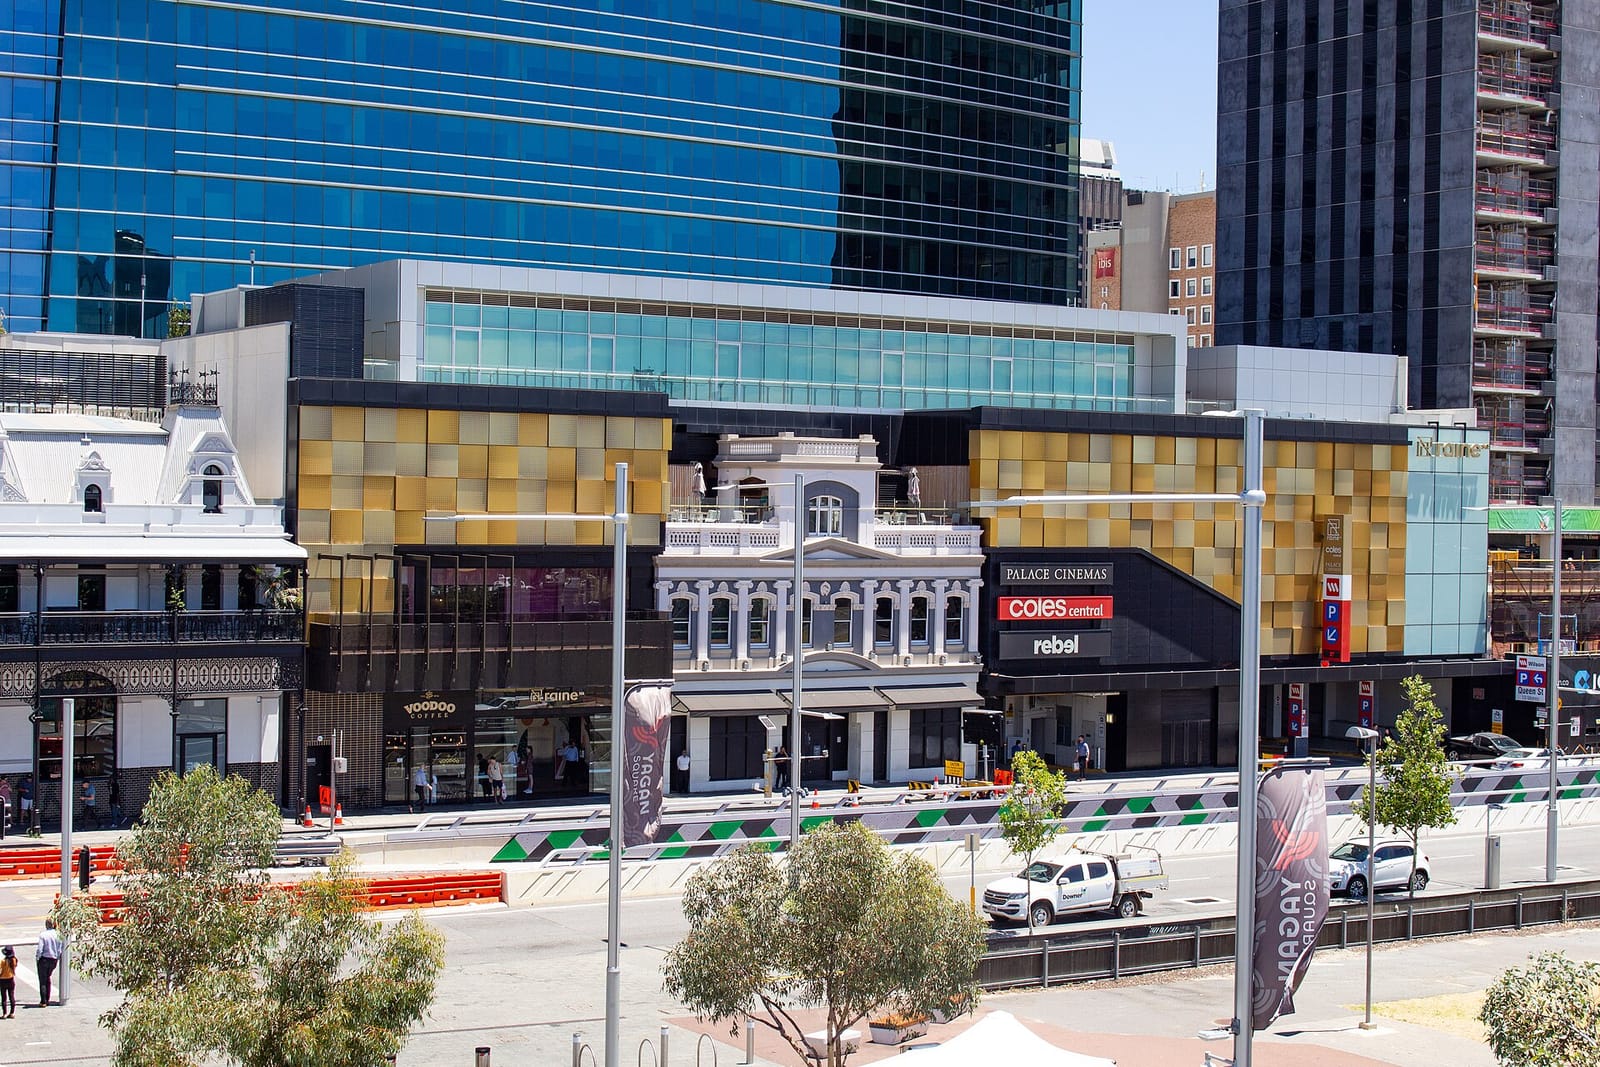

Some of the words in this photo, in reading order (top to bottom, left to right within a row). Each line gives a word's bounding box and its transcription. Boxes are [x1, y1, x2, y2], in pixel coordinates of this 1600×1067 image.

[1098, 257, 1112, 269] ibis
[1006, 568, 1050, 580] PALACE
[1054, 568, 1107, 580] CINEMAS
[1009, 597, 1067, 618] coles
[1068, 603, 1104, 616] central
[1328, 605, 1337, 619] P
[1033, 634, 1079, 655] rebel
[1520, 672, 1528, 684] P
[544, 691, 579, 701] raine
[1517, 686, 1536, 695] Queen
[1537, 688, 1544, 696] St
[403, 700, 456, 714] VOODOO
[1292, 704, 1298, 714] P
[1363, 701, 1369, 710] P
[639, 752, 655, 815] YAGAN
